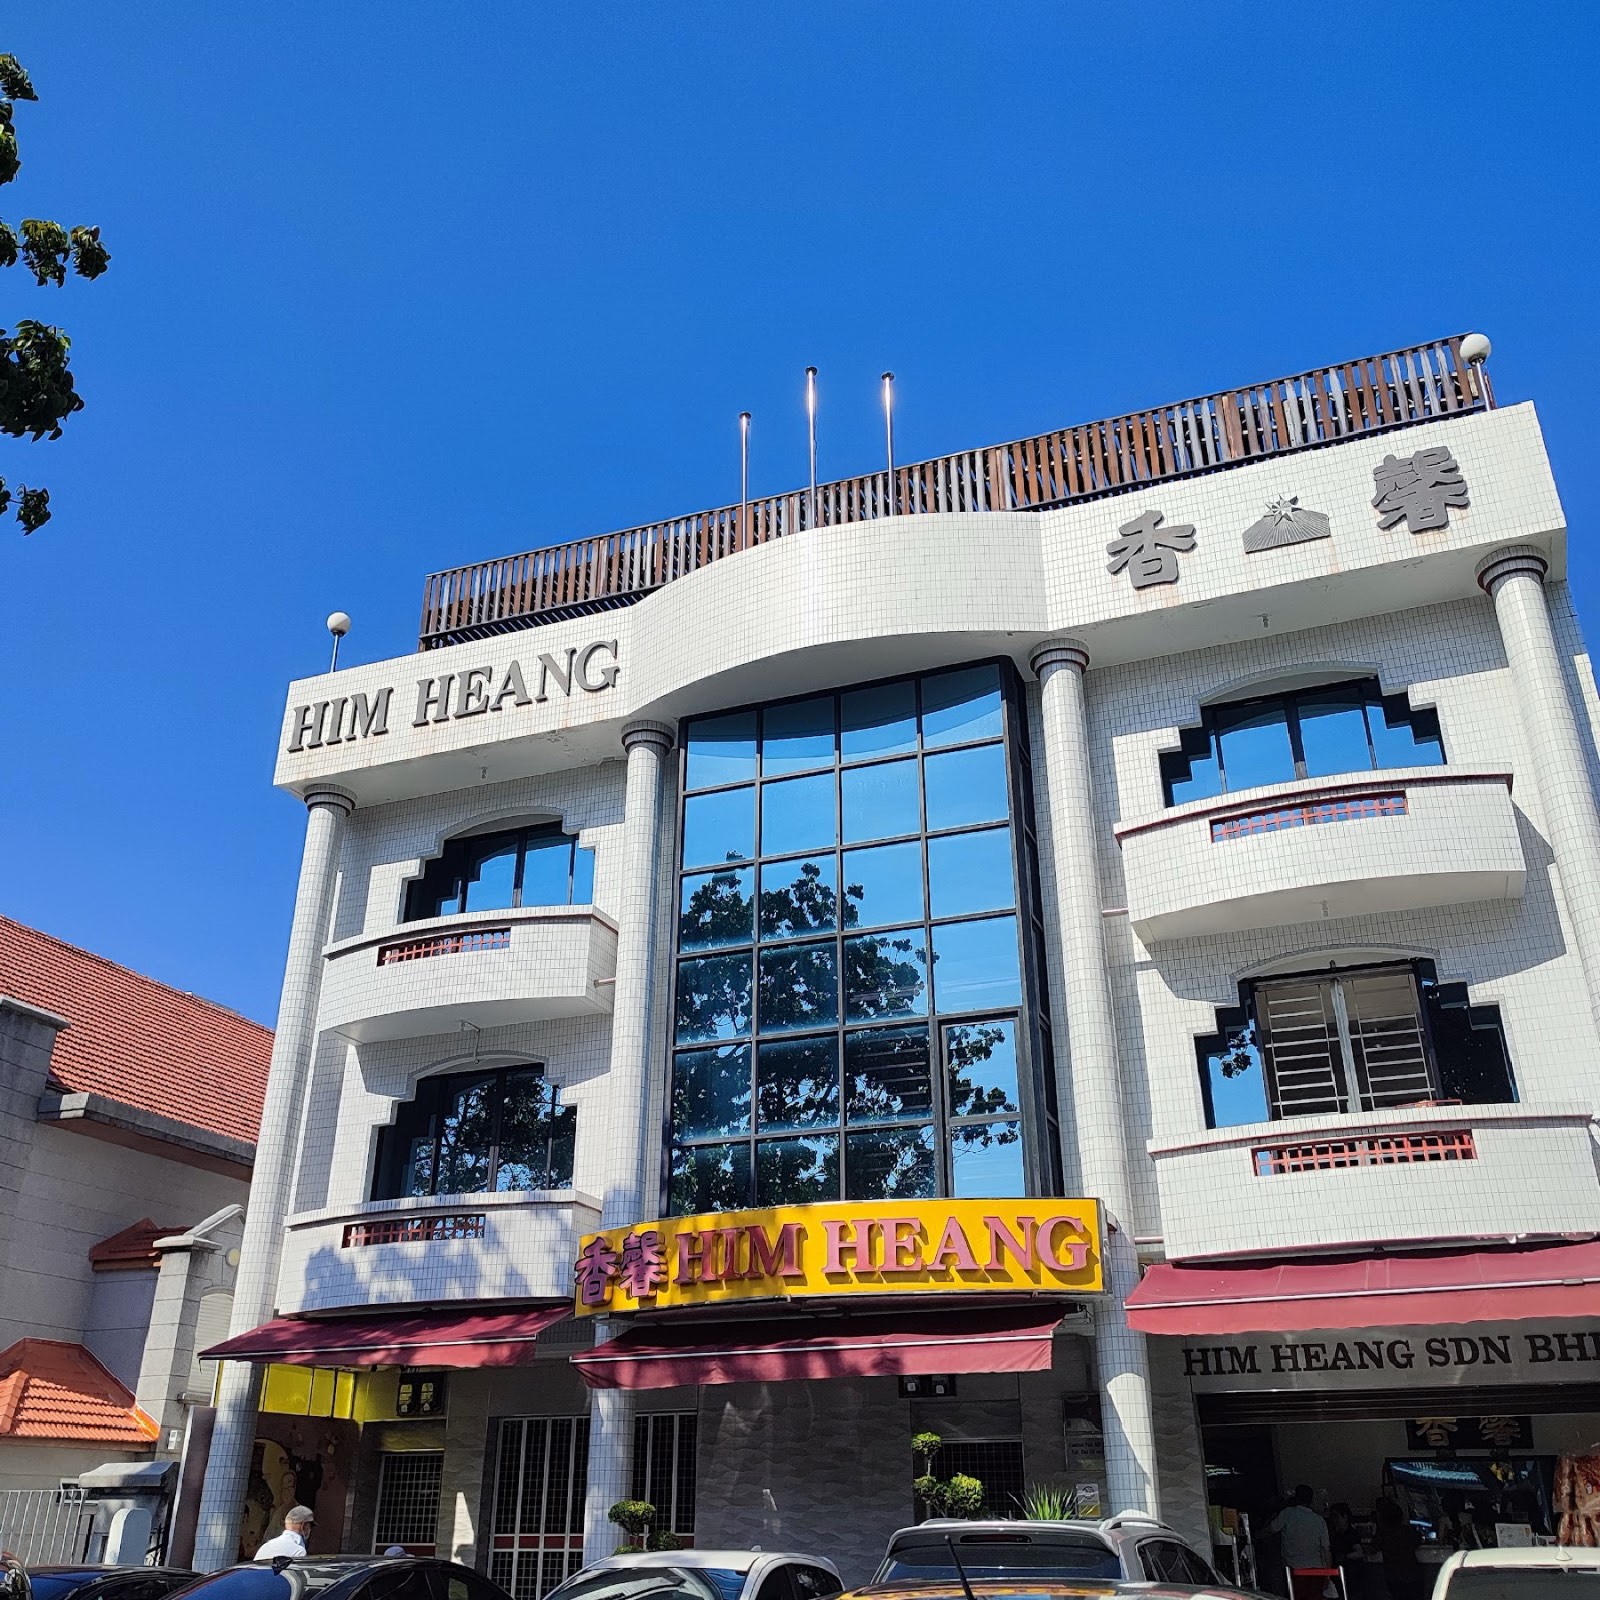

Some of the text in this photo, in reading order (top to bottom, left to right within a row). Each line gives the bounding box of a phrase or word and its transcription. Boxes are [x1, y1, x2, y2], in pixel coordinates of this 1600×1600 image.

[1106, 445, 1470, 589] 香 馨
[287, 639, 620, 752] HIM HEANG
[575, 1216, 1090, 1305] 香馨 HIM HEANG
[1182, 1345, 1262, 1376] HIM
[1270, 1340, 1415, 1373] HEANG
[1425, 1335, 1512, 1368] SDN
